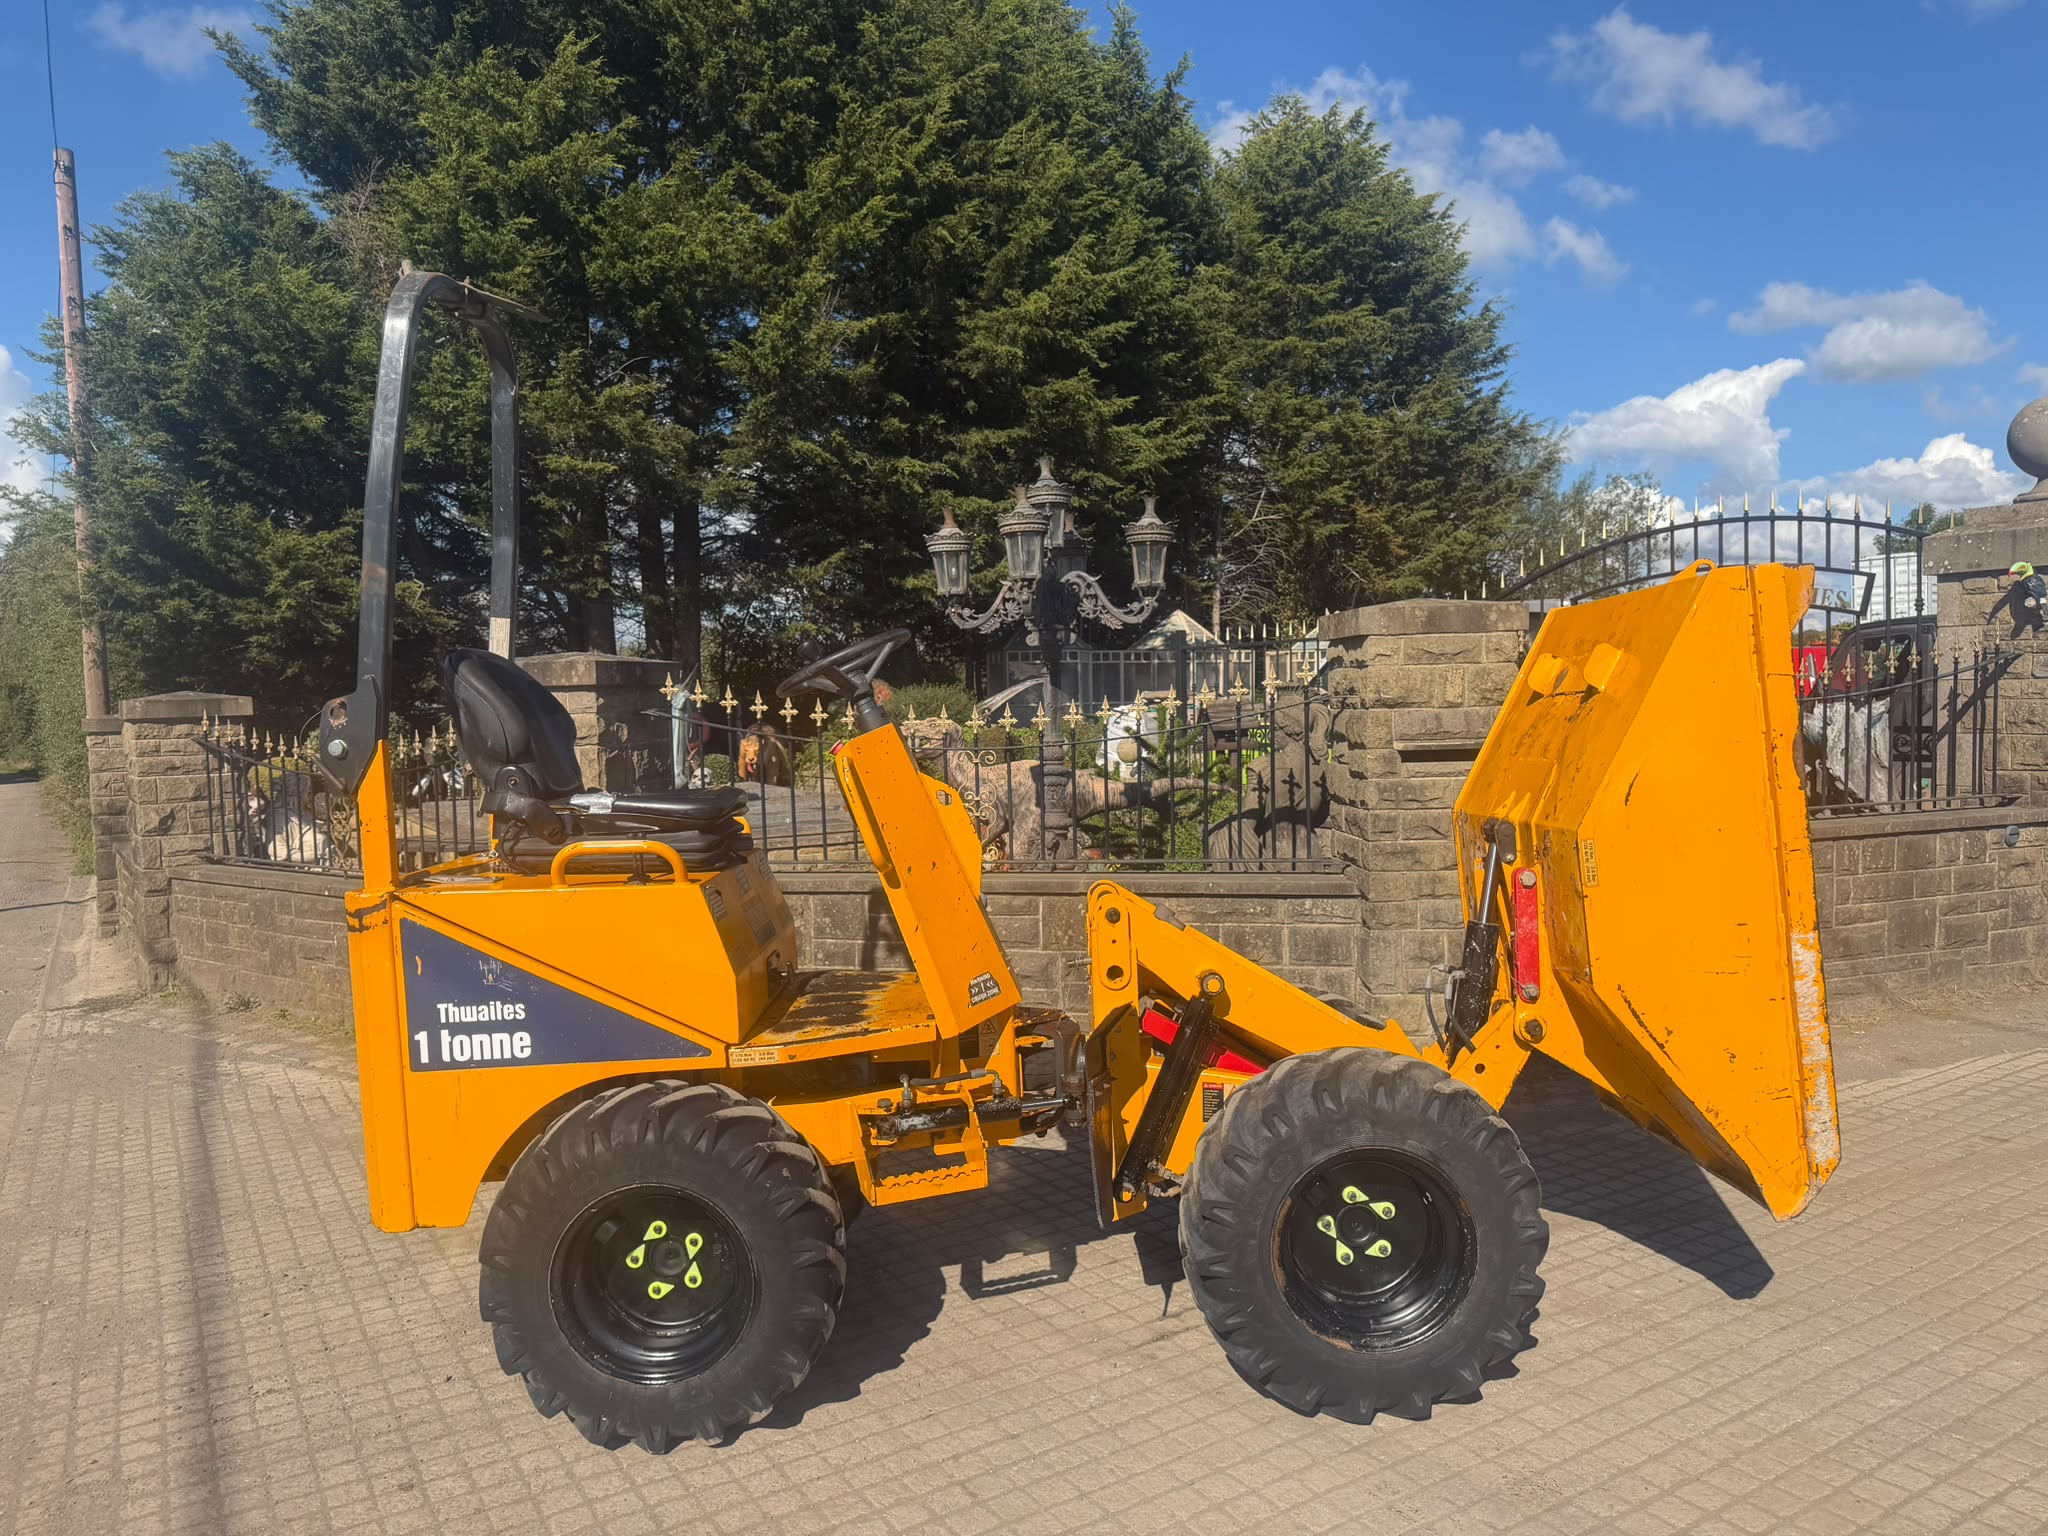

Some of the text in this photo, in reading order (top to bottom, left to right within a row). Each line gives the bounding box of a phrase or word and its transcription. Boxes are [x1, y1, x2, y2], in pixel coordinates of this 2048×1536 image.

[437, 1001, 526, 1024] Thwaites
[414, 1029, 532, 1064] 1 tonne
